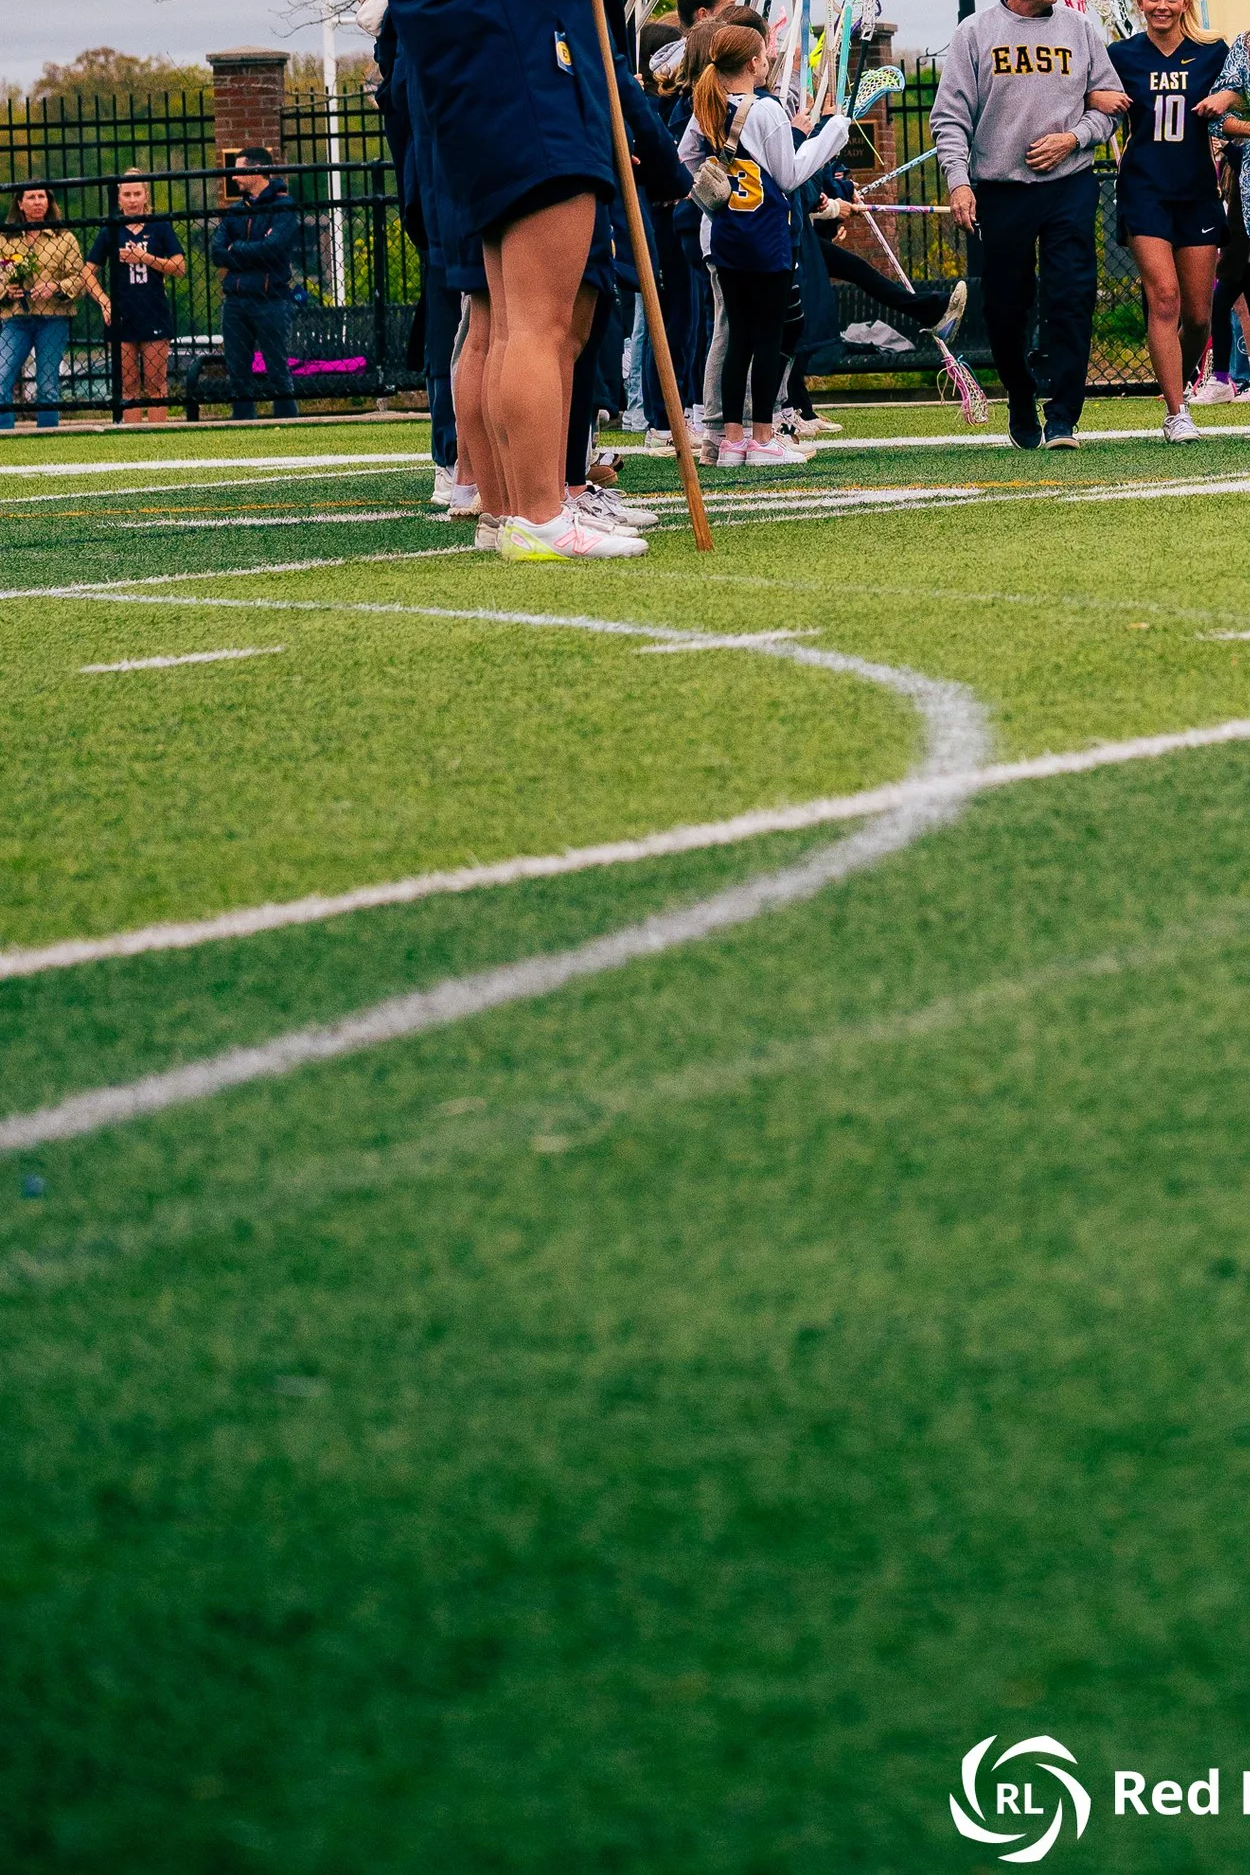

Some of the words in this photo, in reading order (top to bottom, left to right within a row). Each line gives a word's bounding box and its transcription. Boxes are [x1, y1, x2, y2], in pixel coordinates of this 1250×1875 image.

[991, 45, 1072, 75] EAST
[1150, 71, 1188, 91] EAST
[1154, 94, 1186, 142] 10
